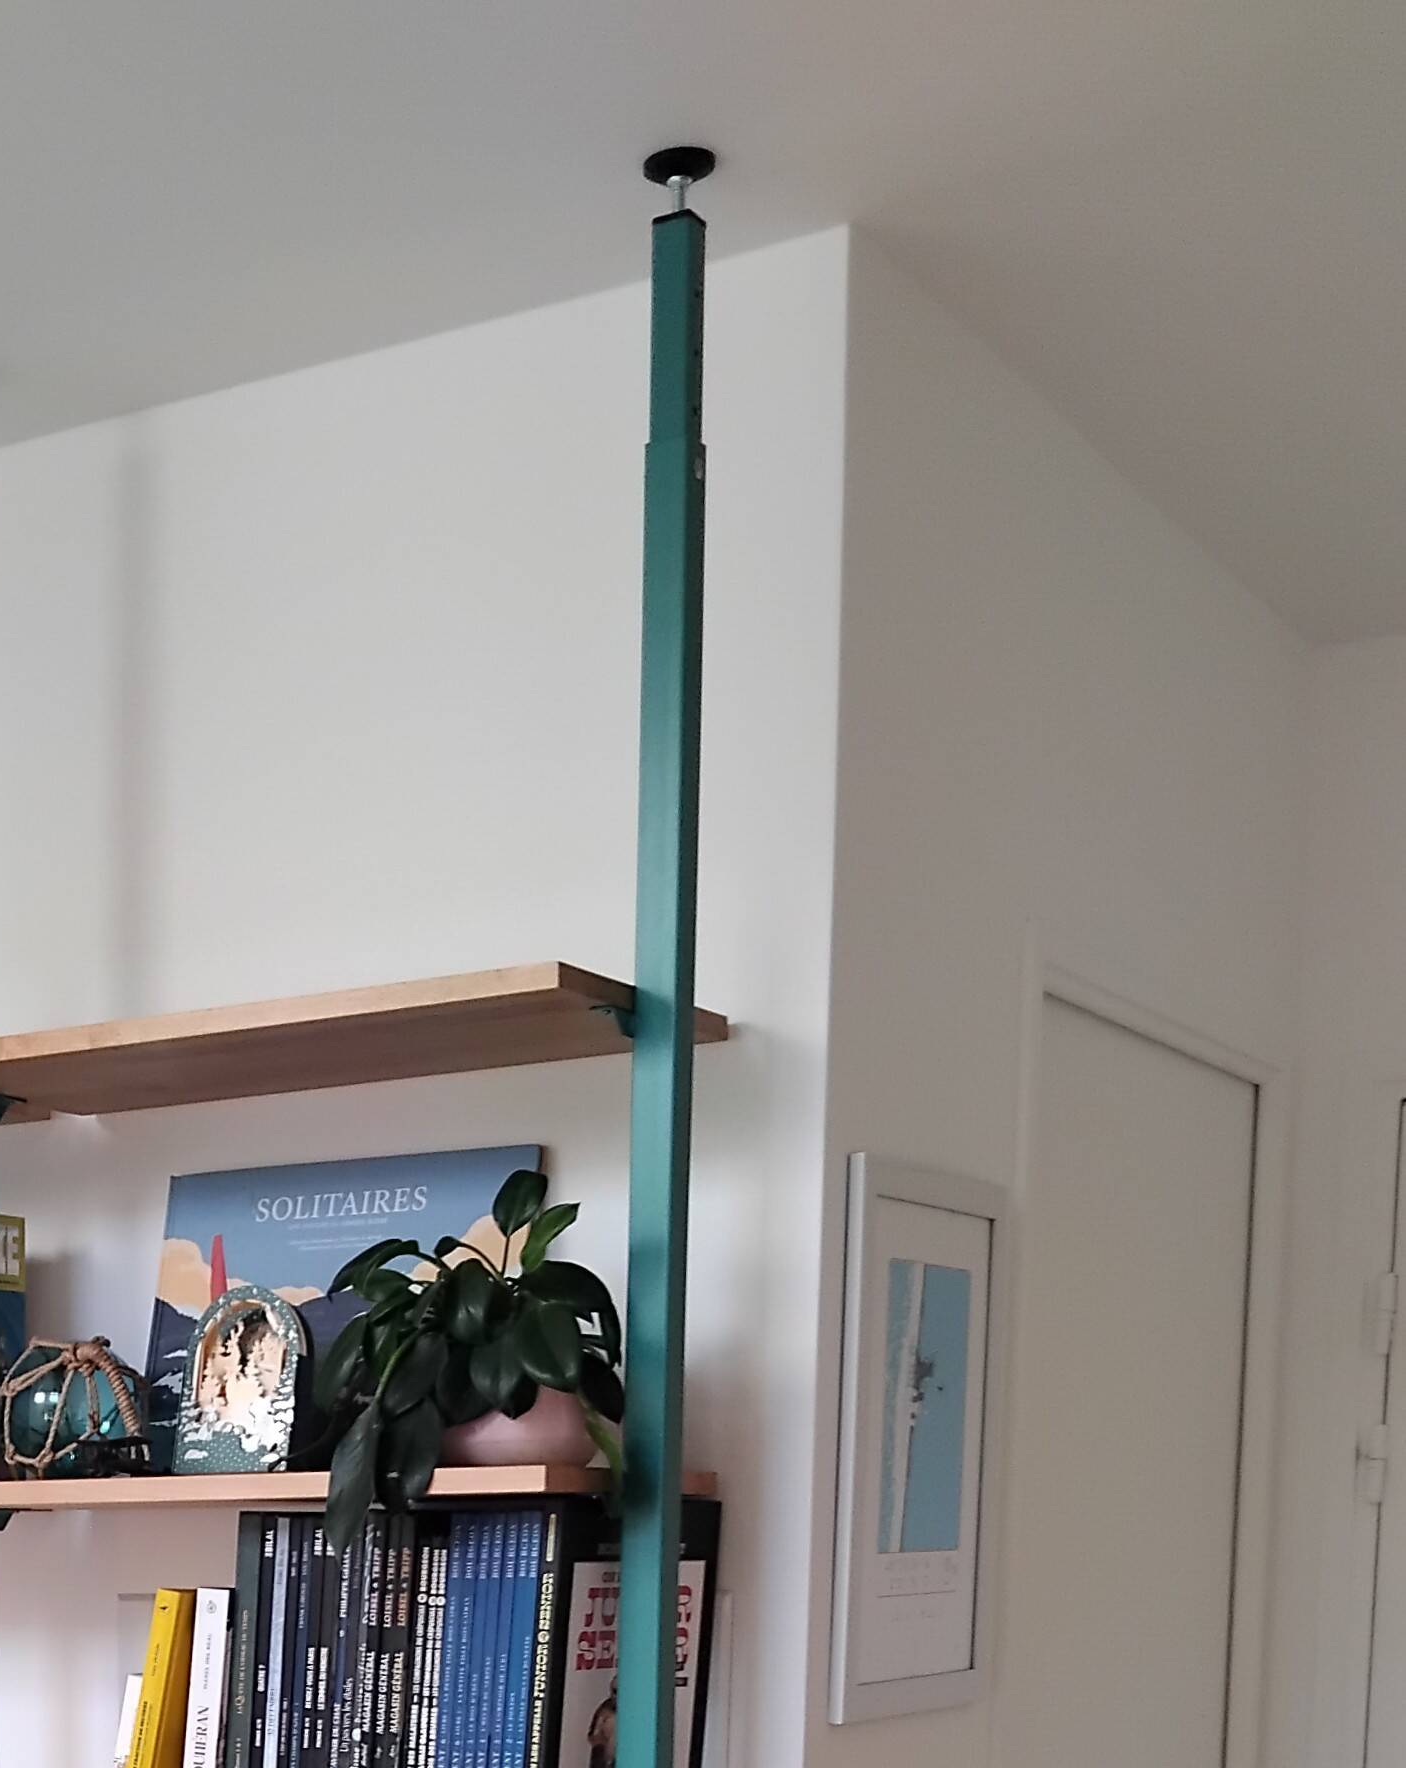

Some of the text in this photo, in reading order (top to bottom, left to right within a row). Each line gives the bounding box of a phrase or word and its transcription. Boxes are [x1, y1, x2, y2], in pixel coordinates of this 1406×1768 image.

[255, 1186, 427, 1222] SOLITAIRES
[372, 1546, 380, 1578] TRIPP
[386, 1547, 395, 1581] TRIPP
[400, 1546, 410, 1579] TRIPP
[419, 1546, 431, 1592] BOURGEON
[429, 1549, 440, 1594] BOURGEON
[339, 1579, 347, 1617] PHILIPPE
[369, 1591, 378, 1626] LOISEL
[382, 1591, 392, 1627] LOISEL
[397, 1591, 407, 1626] LOISEL
[539, 1572, 553, 1630] SENIOR
[427, 1740, 436, 1755] DES
[437, 1548, 448, 1594] BOURGEON
[363, 1650, 375, 1691] GÉNÉRAL
[377, 1652, 389, 1693] GÉNÉRAL
[390, 1651, 403, 1692] GÉNÉRAL
[534, 1643, 547, 1698] JUNIOR
[332, 1701, 340, 1724] CHAT
[340, 1700, 351, 1712] les
[342, 1711, 352, 1728] vers
[360, 1691, 372, 1732] MAGASIN
[375, 1693, 386, 1734] MAGASIN
[388, 1692, 400, 1733] MAGASIN
[531, 1699, 543, 1743] APPELLE
[331, 1725, 339, 1737] DU
[341, 1727, 352, 1741] pas
[409, 1703, 417, 1748] MALATERRE
[339, 1741, 349, 1752] Un
[407, 1749, 415, 1765] DES
[529, 1744, 539, 1762] LES
